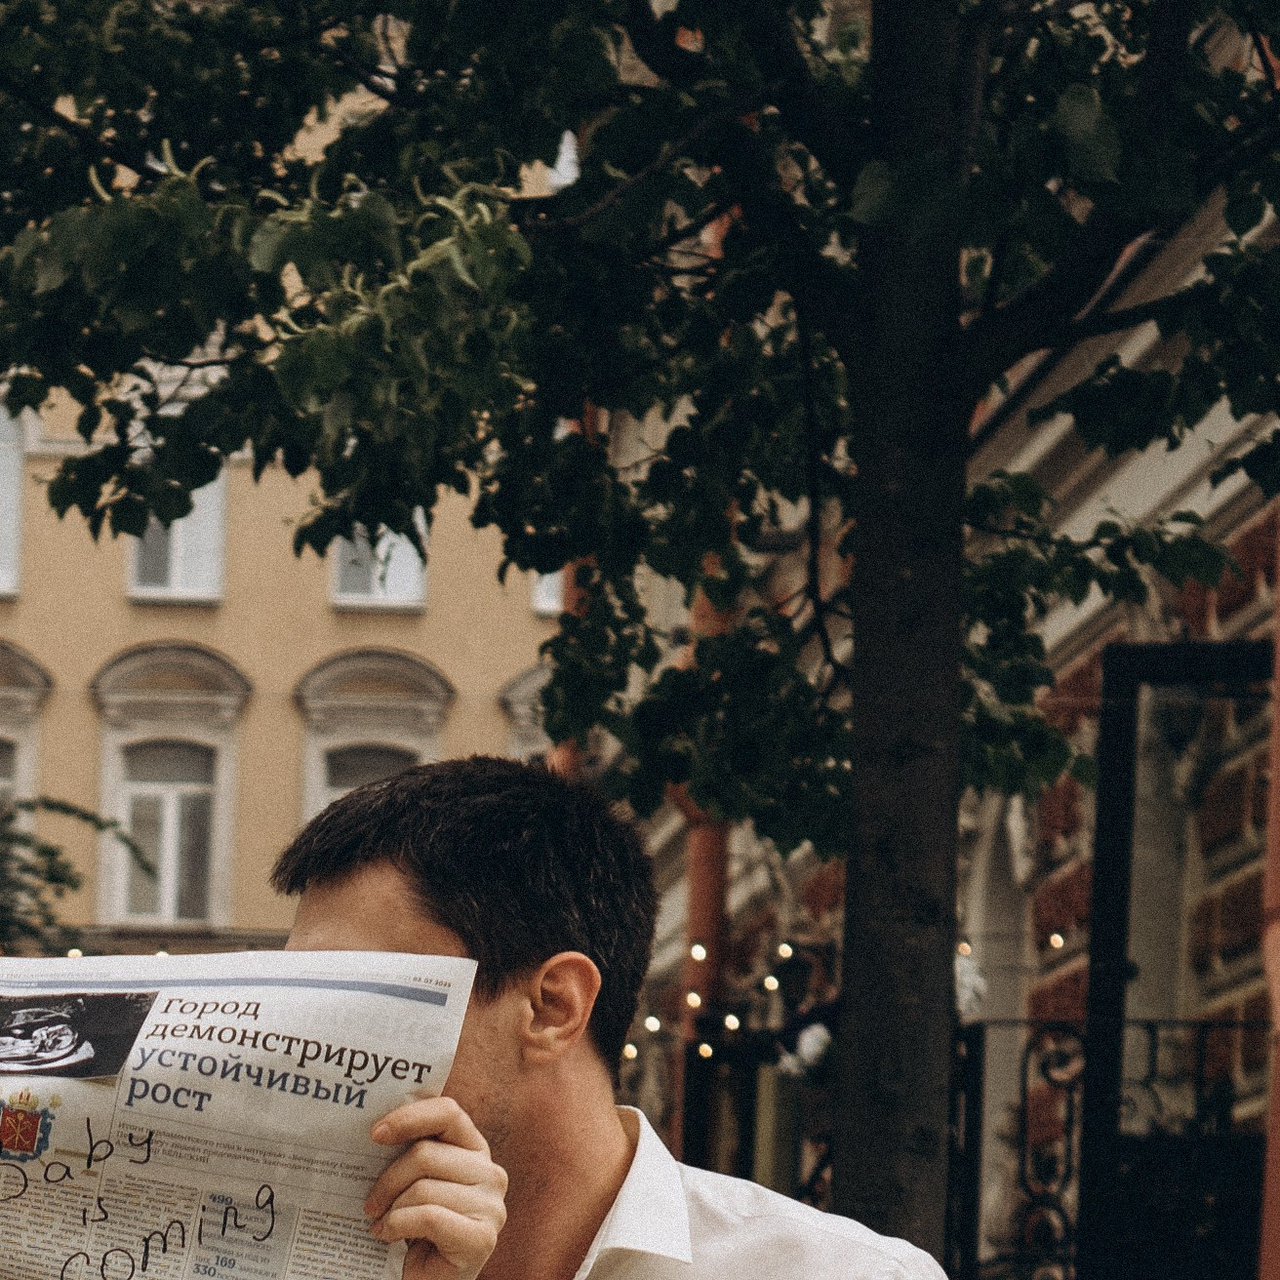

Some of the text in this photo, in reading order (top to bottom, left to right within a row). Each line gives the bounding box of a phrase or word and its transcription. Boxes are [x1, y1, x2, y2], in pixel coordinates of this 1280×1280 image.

[160, 998, 262, 1020] Город
[146, 1022, 432, 1084] демонстрирует
[132, 1046, 368, 1109] устойчивый
[125, 1076, 212, 1112] рост
[82, 1197, 109, 1226] is
[192, 1263, 217, 1277] 330
[215, 1255, 236, 1269] 169
